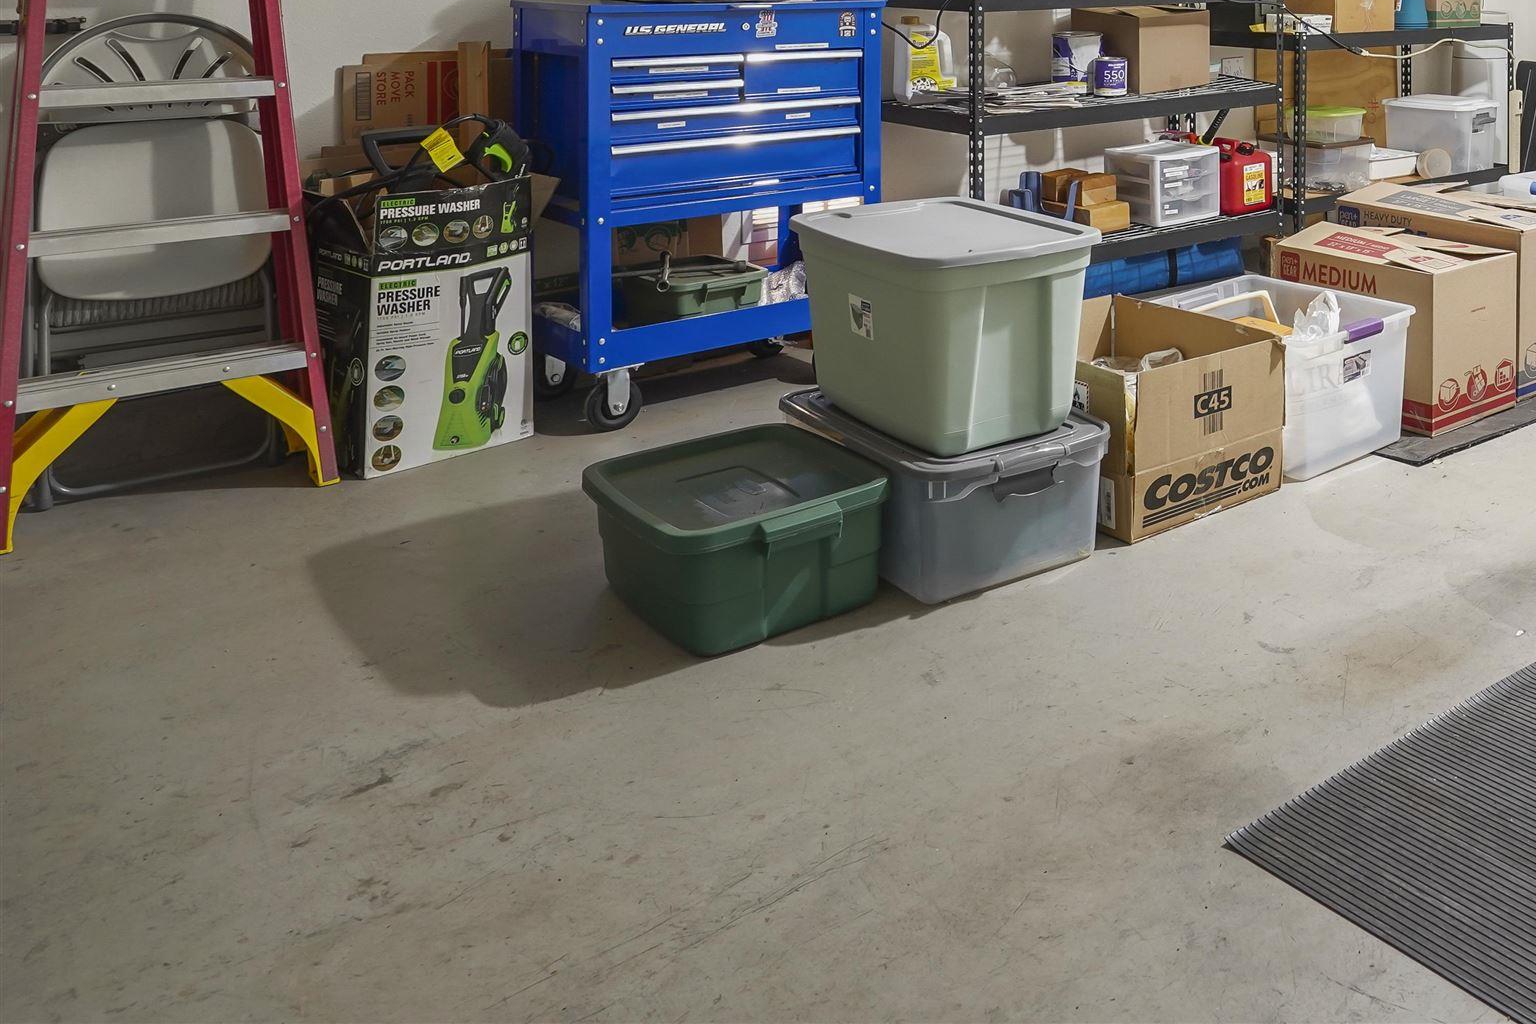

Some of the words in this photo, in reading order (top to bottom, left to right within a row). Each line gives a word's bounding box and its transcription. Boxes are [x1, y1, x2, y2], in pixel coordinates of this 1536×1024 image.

[654, 22, 727, 35] GENERAL
[405, 70, 415, 98] PACK
[1103, 70, 1125, 80] 550
[376, 71, 387, 106] STORE
[390, 71, 401, 103] MOVE
[380, 204, 436, 220] PRESSURE
[438, 199, 481, 214] WASHER
[382, 199, 415, 207] ELECTRIC
[1364, 210, 1389, 224] HEAVY
[1391, 215, 1413, 227] DUTY
[1335, 236, 1366, 246] MEDIUM
[378, 252, 471, 272] PORTLAND
[380, 280, 417, 289] ELECTRIC
[1303, 261, 1377, 294] MEDIUM
[377, 286, 440, 304] PRESSURE
[377, 299, 431, 316] WASHER
[1196, 390, 1230, 414] C45
[1143, 446, 1274, 511] COSTCO
[1237, 472, 1270, 494] .COM
